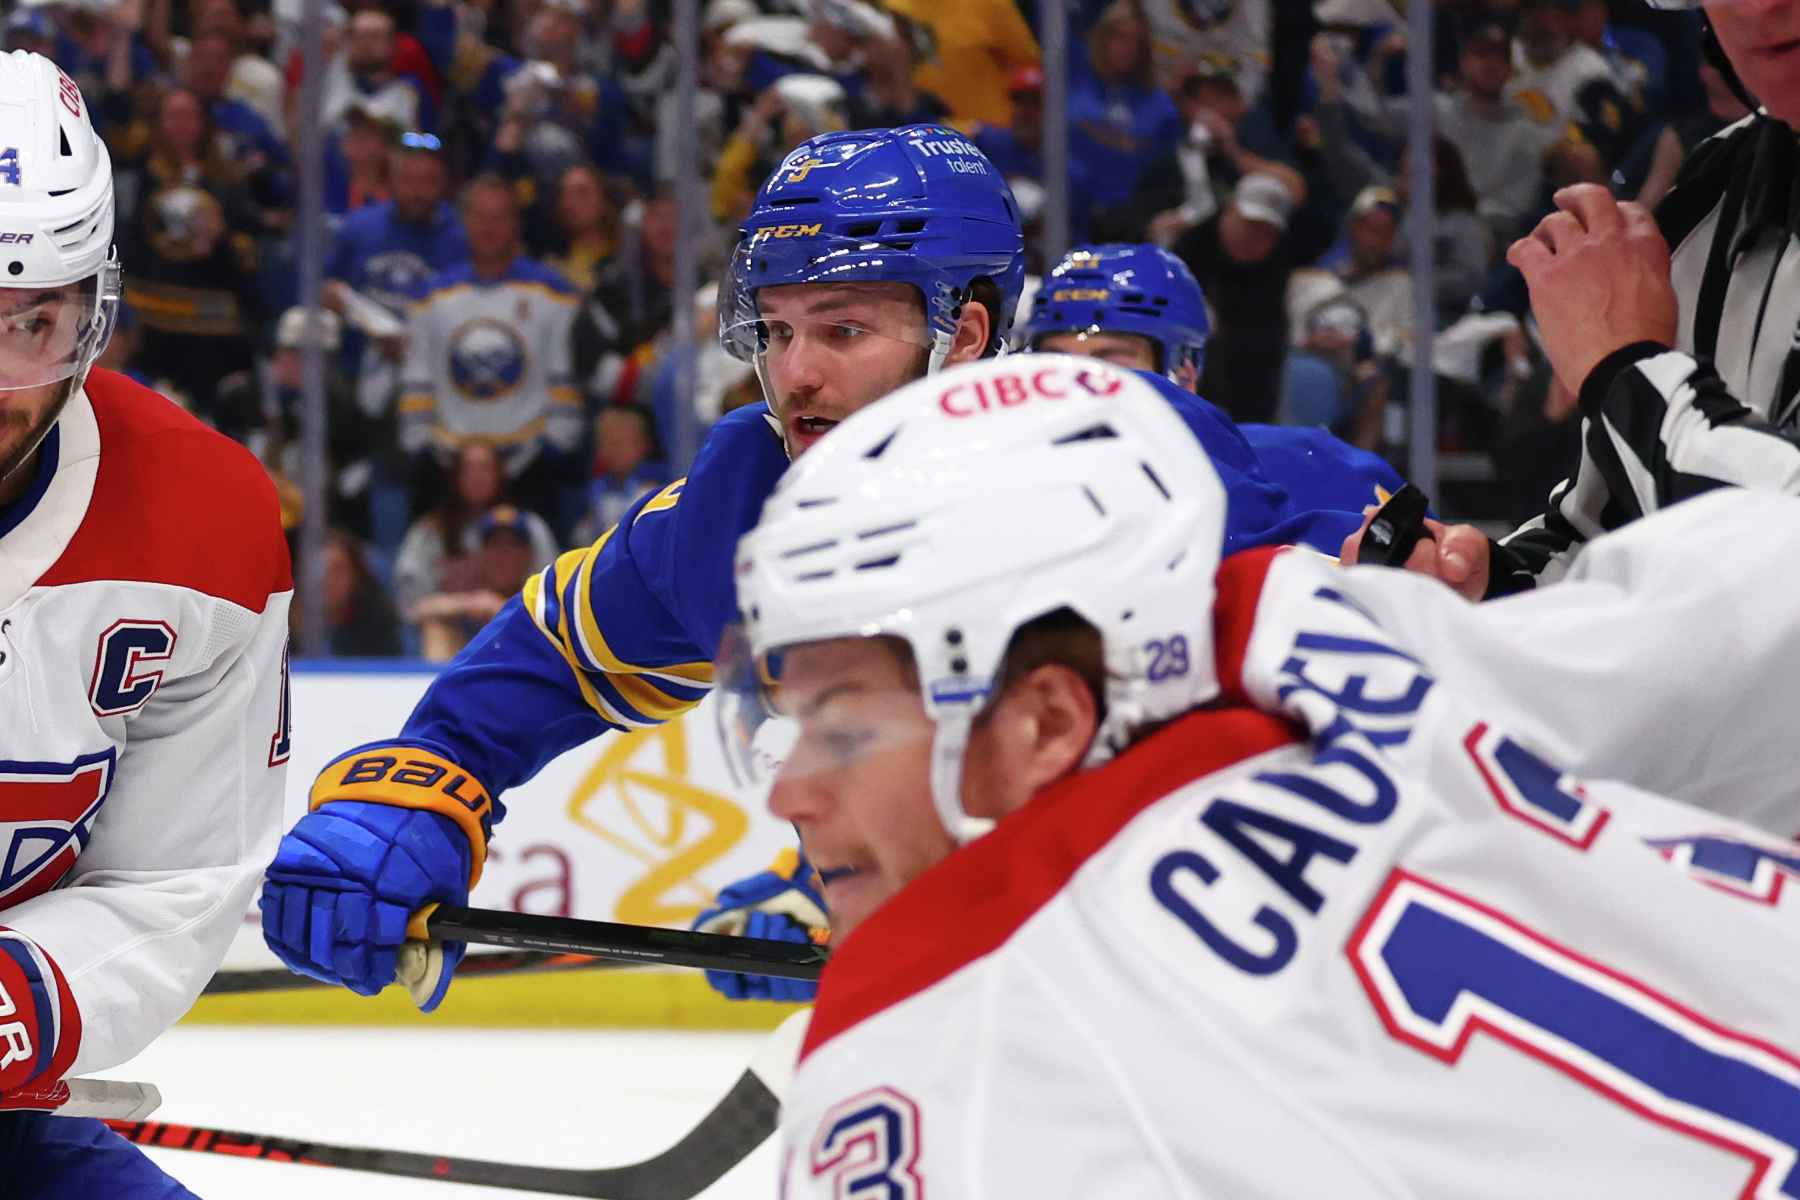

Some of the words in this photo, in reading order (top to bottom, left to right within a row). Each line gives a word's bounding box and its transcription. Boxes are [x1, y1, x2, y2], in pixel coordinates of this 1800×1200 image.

[946, 156, 988, 175] talent
[757, 222, 823, 239] CCM
[939, 367, 1069, 418] CIBC
[88, 618, 178, 717] C
